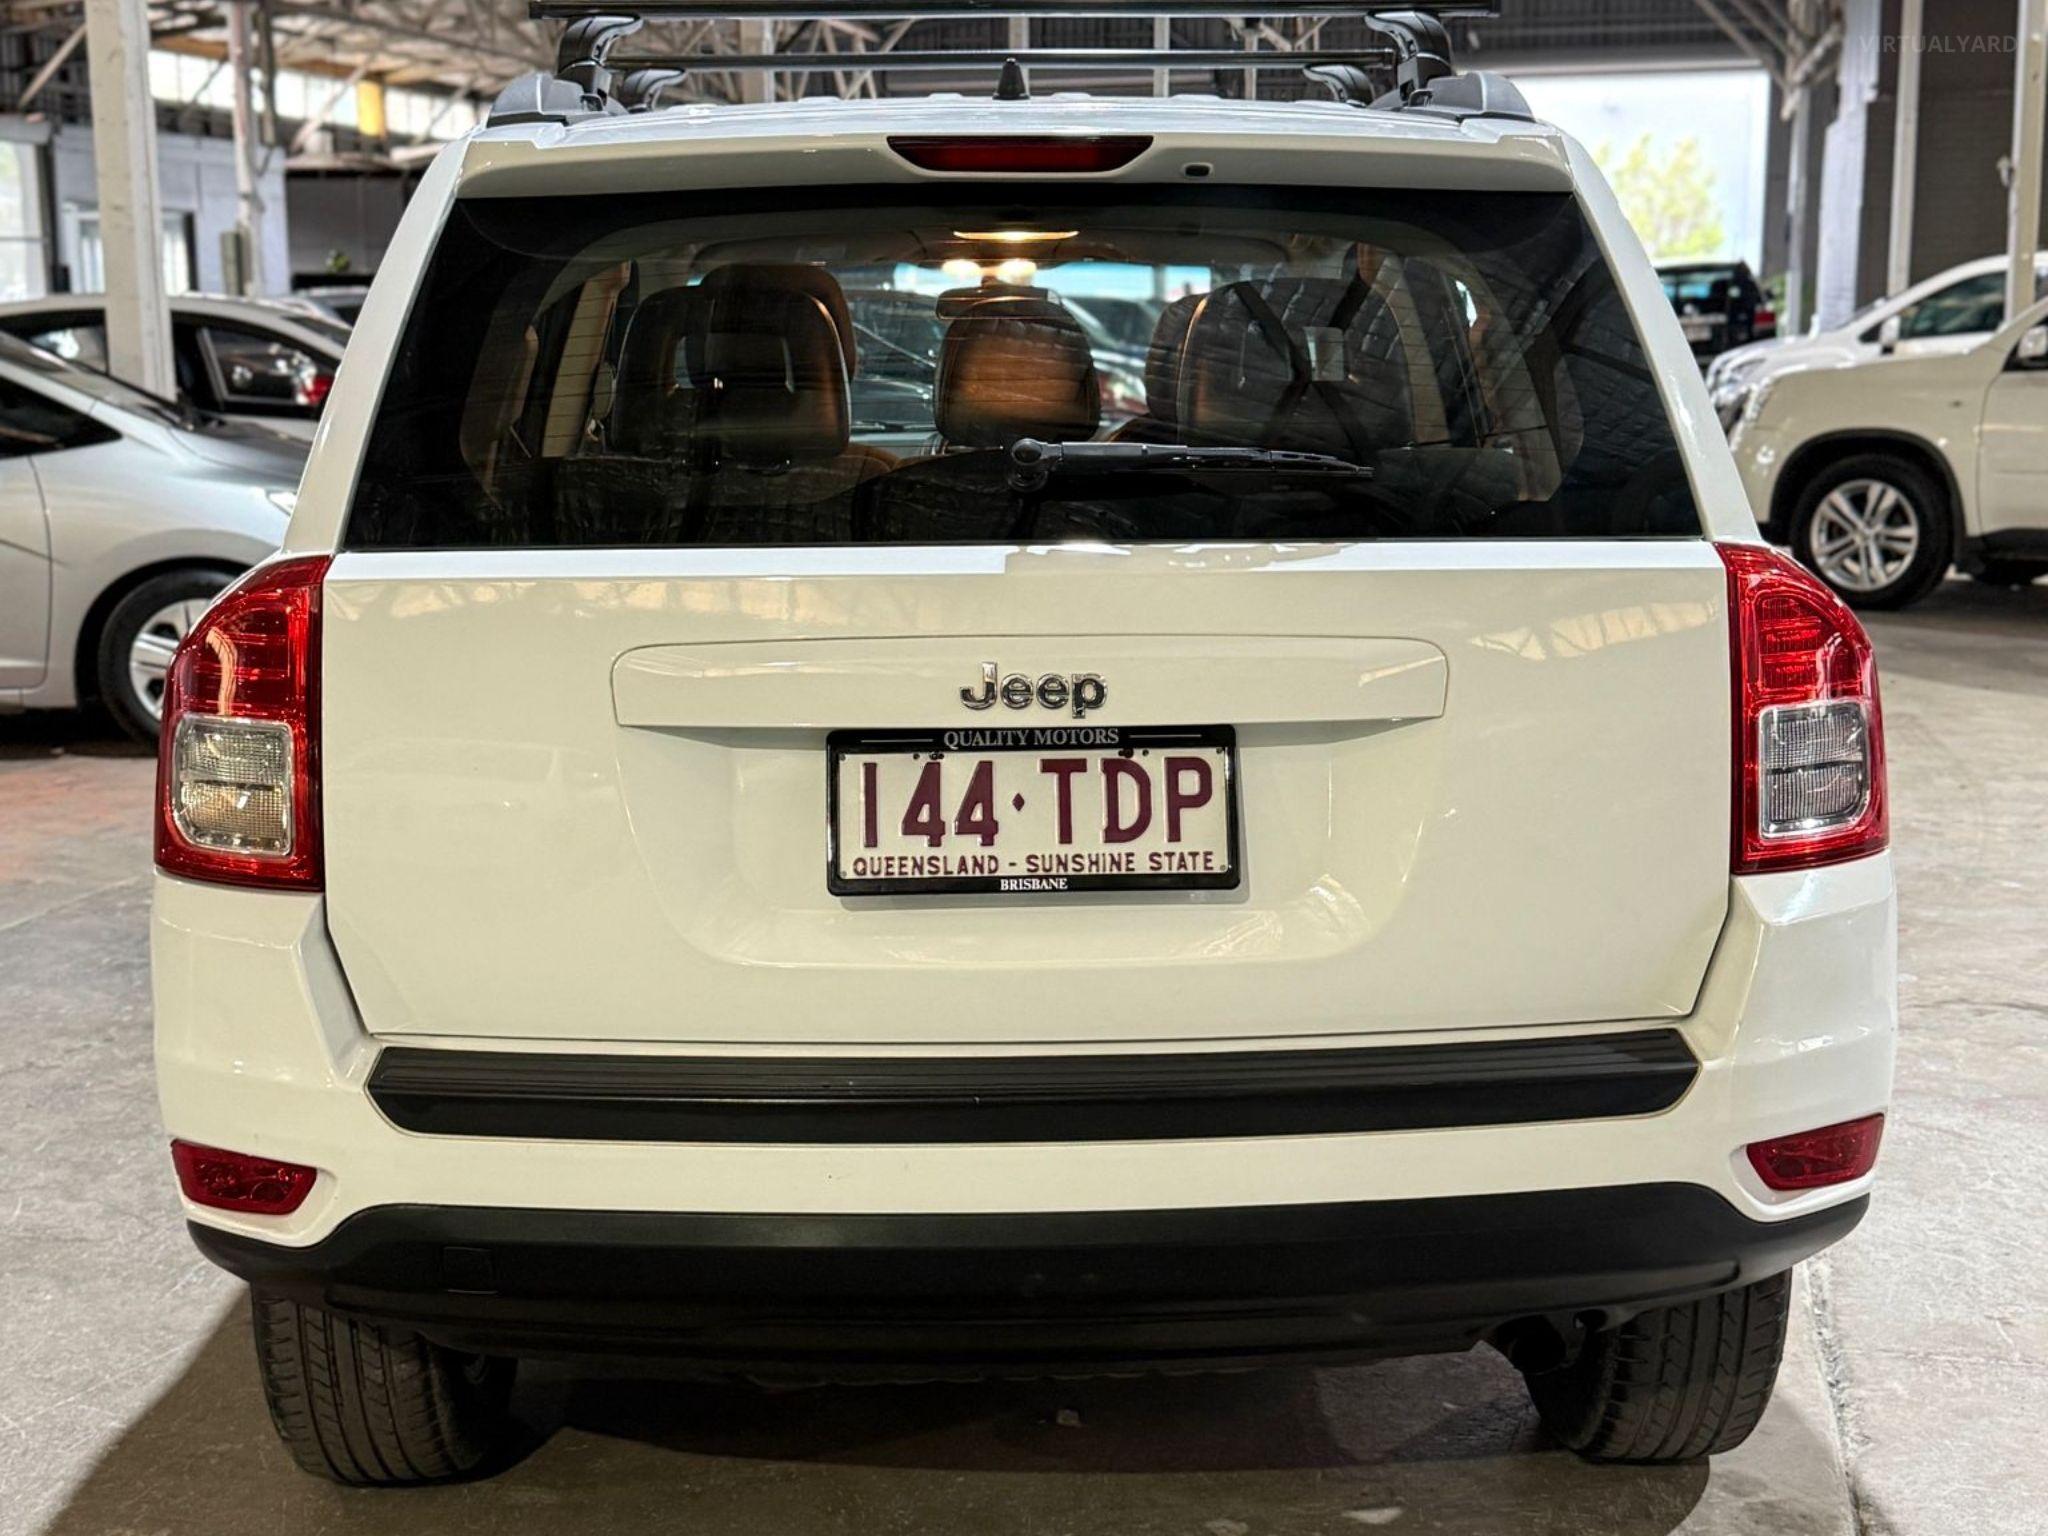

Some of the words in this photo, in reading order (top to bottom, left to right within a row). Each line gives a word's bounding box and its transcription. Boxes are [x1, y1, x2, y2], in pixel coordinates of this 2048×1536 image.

[960, 662, 1107, 719] Jeep
[943, 729, 1029, 749] QUALITY
[1034, 728, 1119, 746] MOTORS
[853, 855, 1000, 877] QUEENSLAND
[1025, 852, 1136, 874] SUNSHINE
[1149, 850, 1214, 872] STATE
[1000, 878, 1068, 891] BRISBANE
